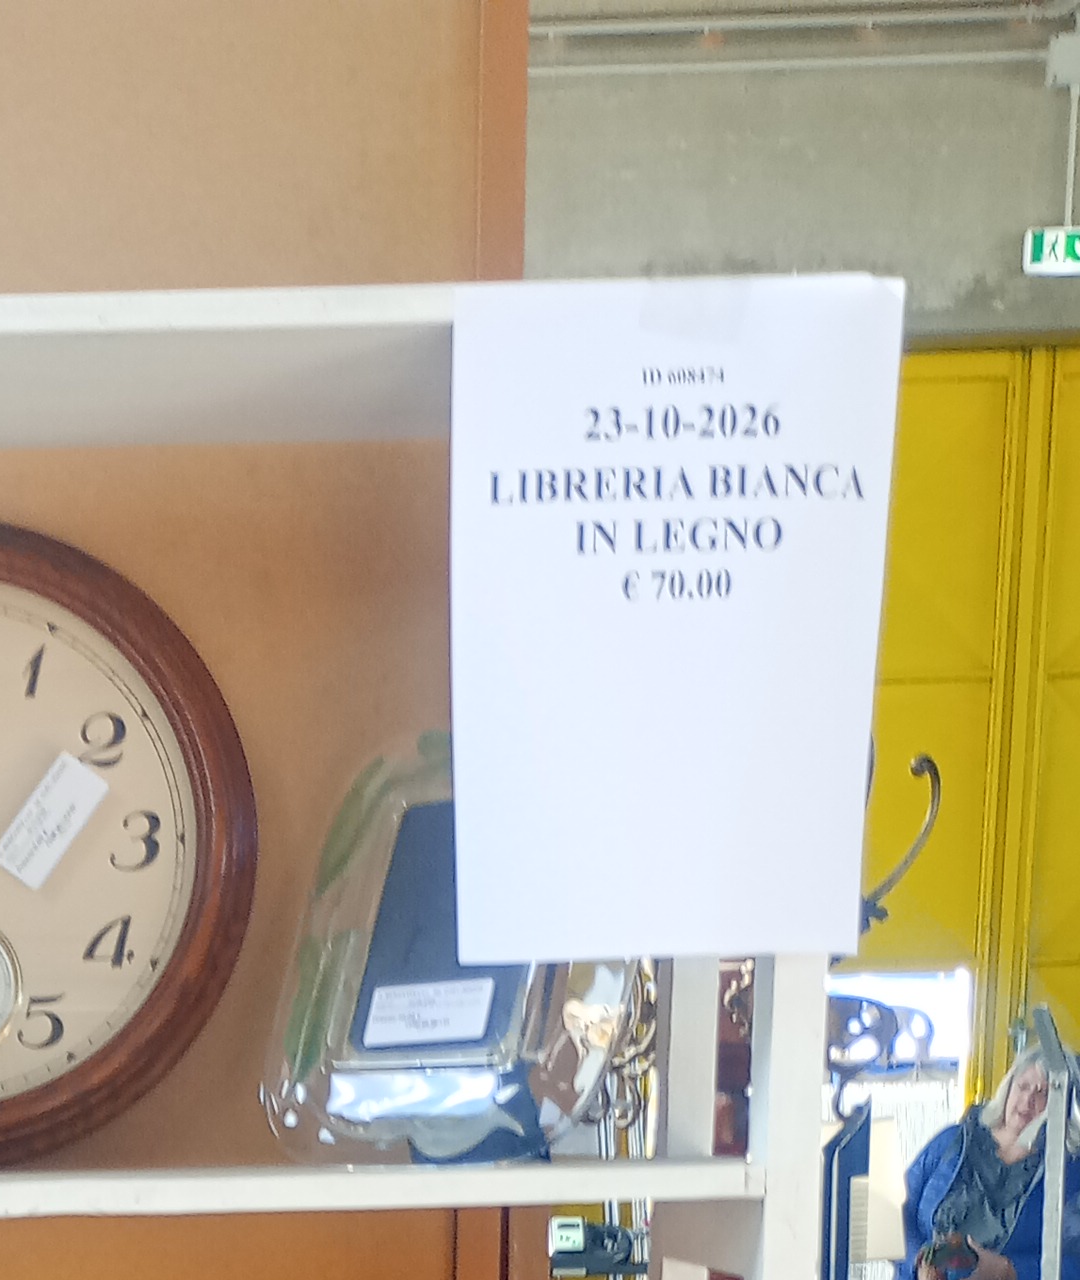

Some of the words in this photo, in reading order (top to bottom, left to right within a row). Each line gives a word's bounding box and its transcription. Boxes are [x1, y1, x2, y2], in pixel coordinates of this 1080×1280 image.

[642, 368, 663, 384] ID
[584, 403, 781, 441] 23-10-2026
[489, 465, 694, 505] LIBRERIA
[708, 463, 865, 500] BIANCA
[575, 519, 617, 555] IN
[634, 515, 783, 554] LEGNO
[651, 567, 732, 600] 70.00
[23, 642, 47, 699] 1
[80, 711, 127, 768] 2
[109, 810, 161, 872] 3
[82, 914, 134, 969] 4
[17, 993, 65, 1049] 5
